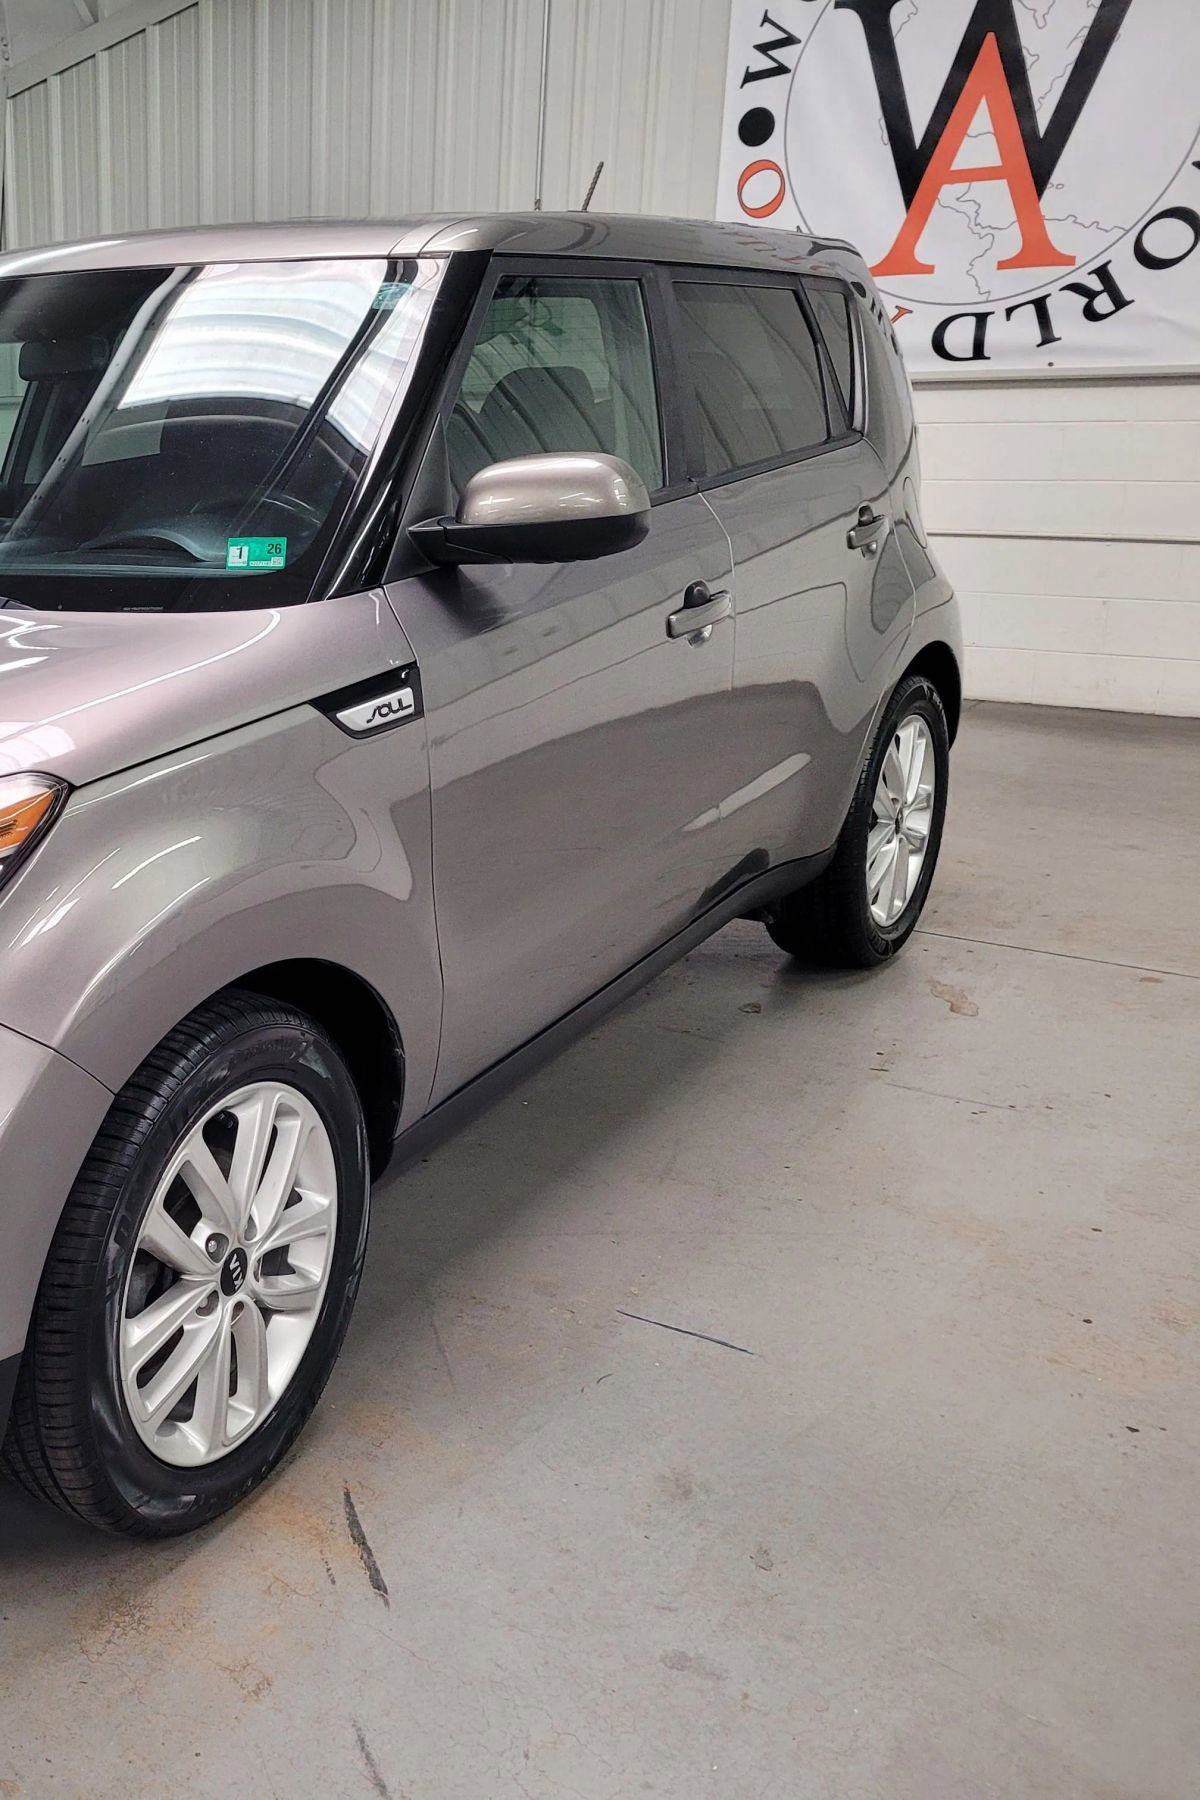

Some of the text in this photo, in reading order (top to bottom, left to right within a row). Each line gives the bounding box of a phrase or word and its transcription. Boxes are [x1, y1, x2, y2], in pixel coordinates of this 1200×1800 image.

[931, 161, 1200, 361] ORLD
[267, 543, 282, 555] 26
[229, 1253, 244, 1291] KIA
